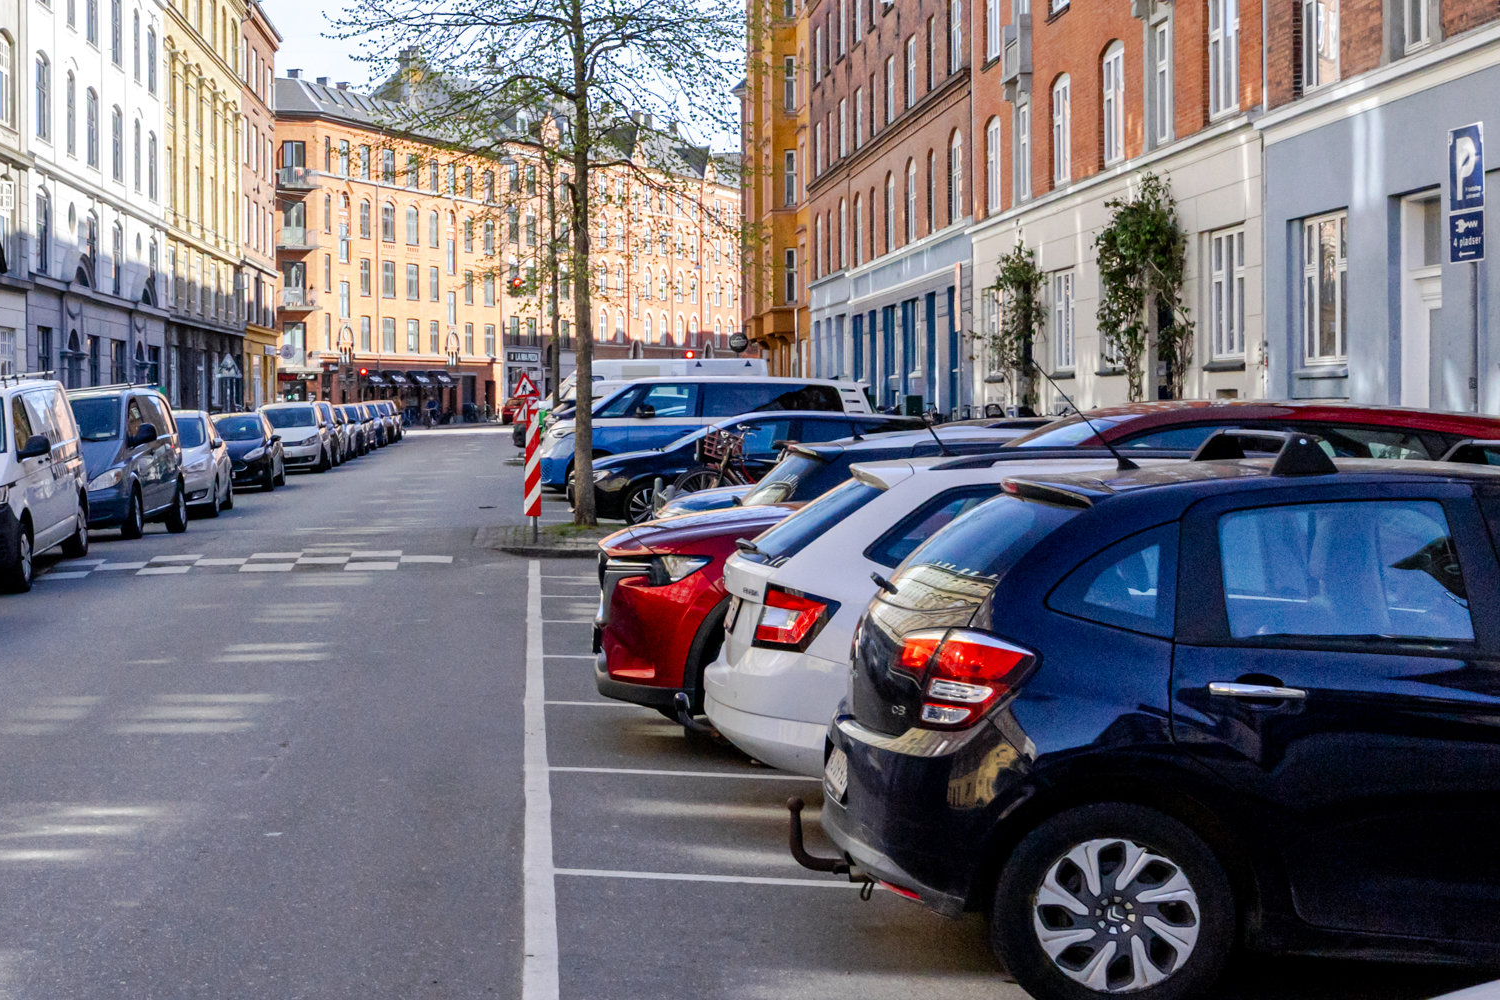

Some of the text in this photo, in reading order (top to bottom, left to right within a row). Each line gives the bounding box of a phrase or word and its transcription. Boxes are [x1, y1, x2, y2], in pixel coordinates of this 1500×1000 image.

[1456, 136, 1477, 200] P
[1453, 236, 1481, 248] 4 pladser
[892, 705, 906, 715] C3
